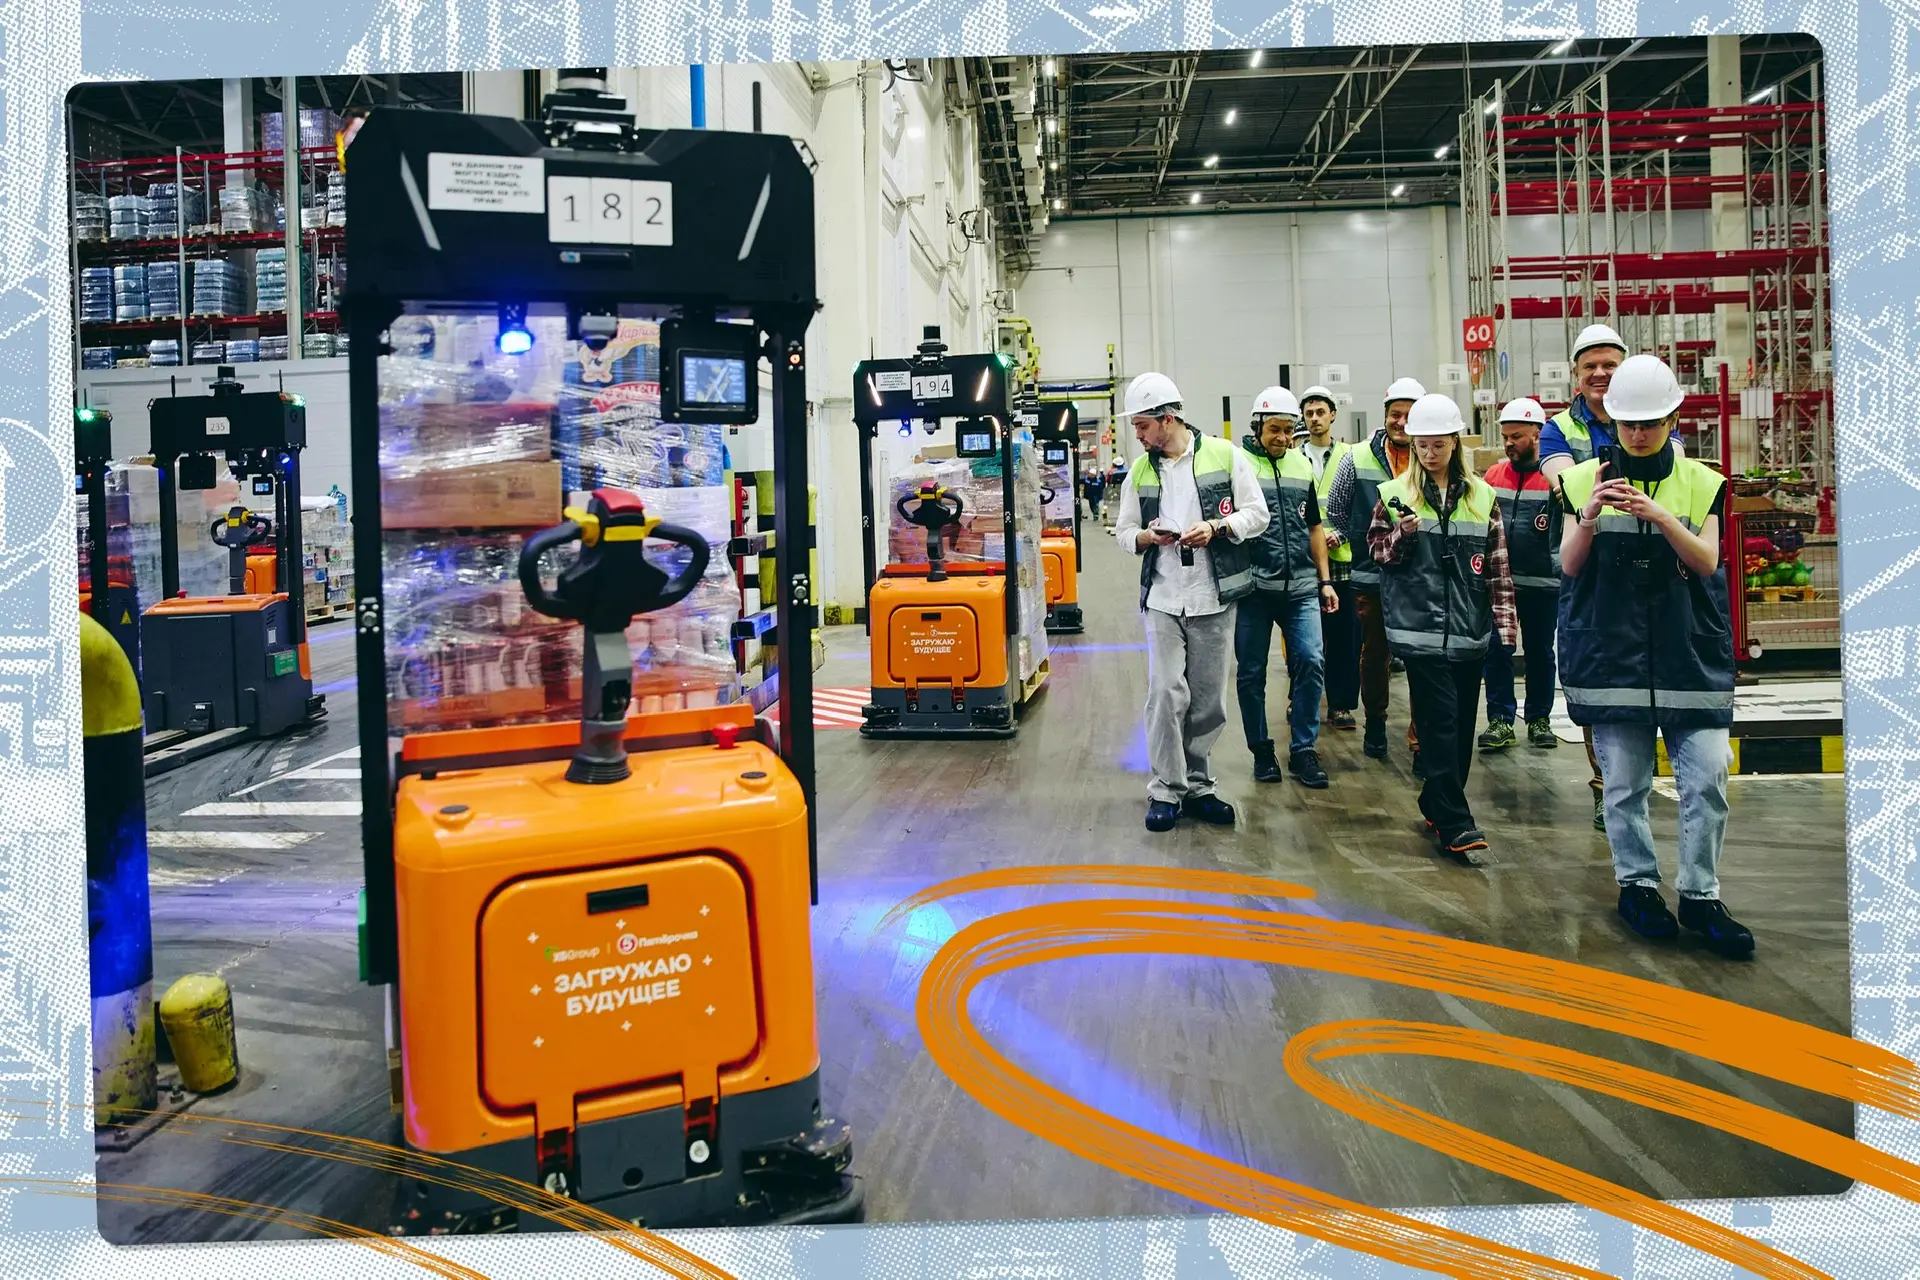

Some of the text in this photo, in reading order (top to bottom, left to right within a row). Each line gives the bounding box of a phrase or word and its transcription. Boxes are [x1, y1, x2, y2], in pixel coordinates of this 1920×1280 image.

[563, 192, 664, 226] 182
[1466, 324, 1491, 343] 60
[915, 379, 951, 397] 194
[210, 423, 226, 431] 235
[1022, 416, 1038, 425] 252
[911, 638, 955, 646] ЗАГРУЖАЮ
[914, 646, 951, 654] БУДУЩЕЕ
[554, 953, 692, 994] ЗАГРУЖАЮ
[566, 979, 681, 1017] БУДУЩЕЕ
